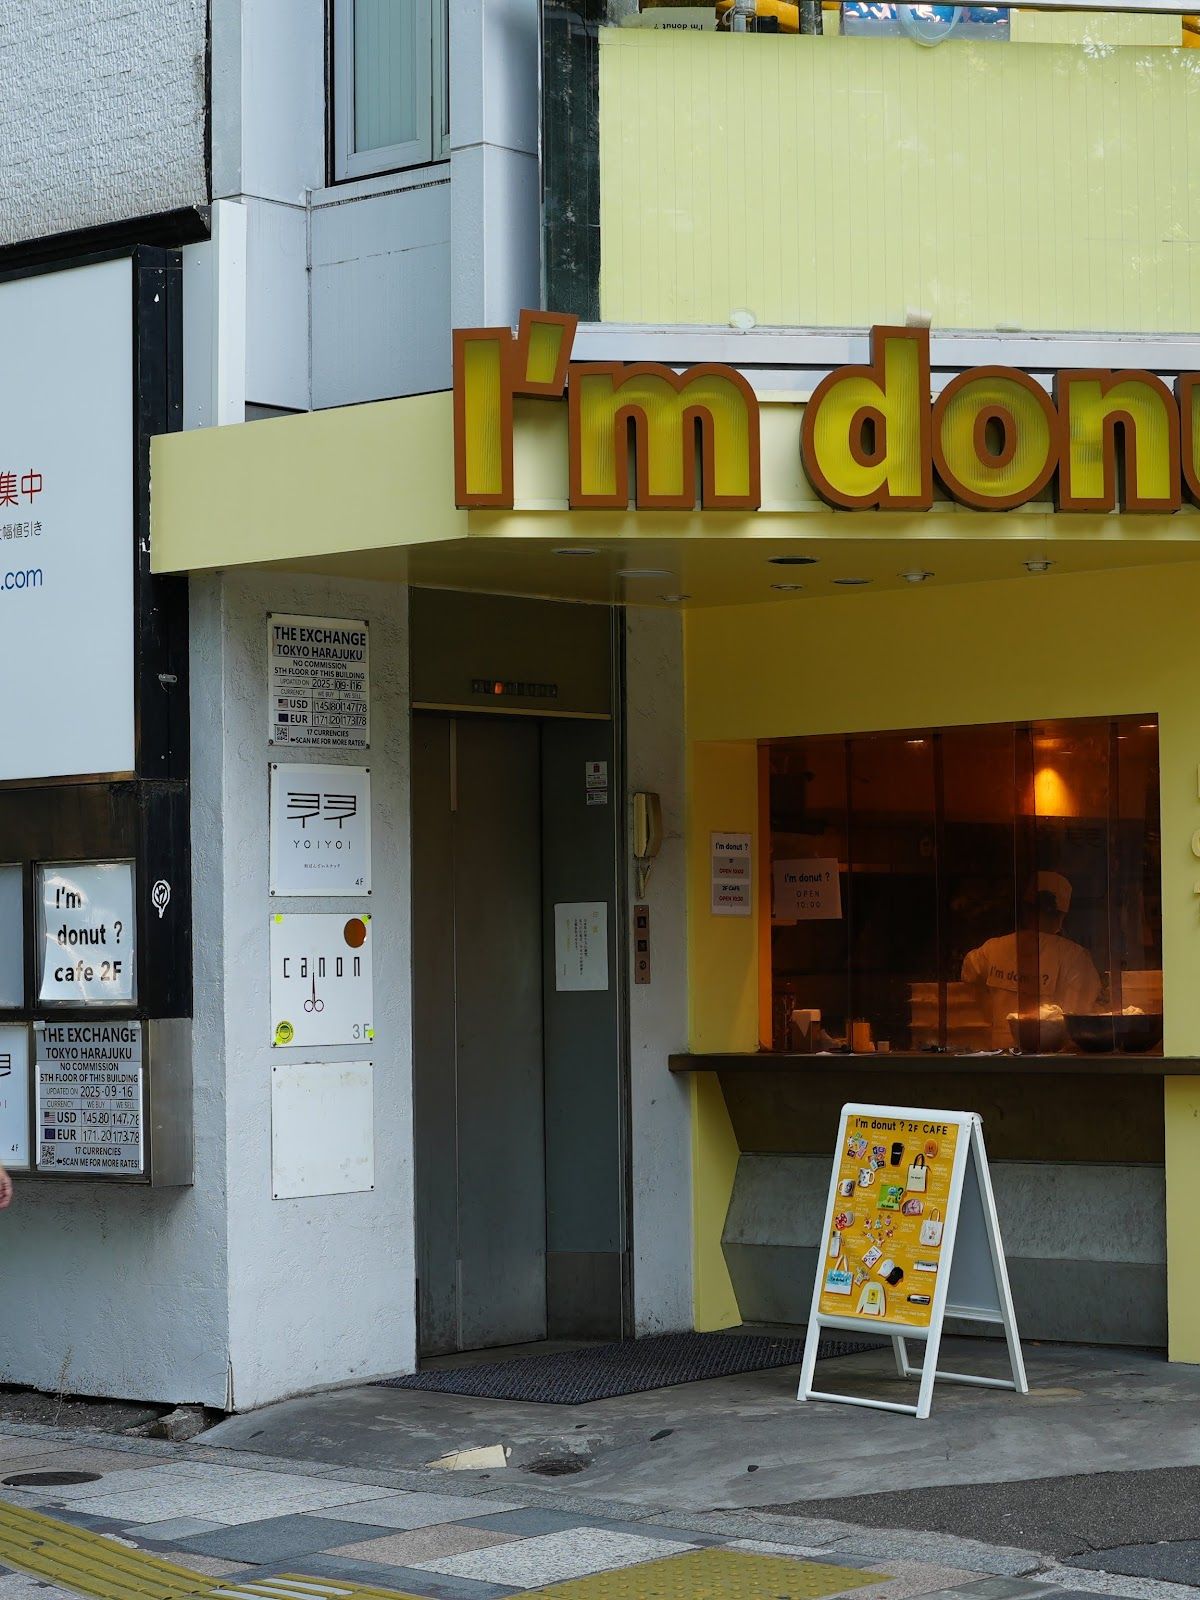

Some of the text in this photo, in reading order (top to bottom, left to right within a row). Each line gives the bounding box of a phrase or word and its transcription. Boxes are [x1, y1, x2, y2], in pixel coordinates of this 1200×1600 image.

[453, 309, 760, 511] I'm
[0, 521, 42, 540] 幅値引き
[0, 568, 42, 590] .com
[274, 626, 366, 646] THE EXCHANGE
[277, 644, 362, 660] TOKYO HARAJUKU
[305, 660, 346, 670] COMMISSION
[289, 668, 309, 676] FLOOR
[320, 670, 334, 678] THIS
[336, 671, 364, 679] BUILDING
[290, 700, 308, 709] USD
[290, 714, 308, 723] EUR
[314, 729, 348, 737] CURRENCIES
[293, 840, 351, 850] YOIYOI
[716, 842, 724, 850] I'm
[785, 873, 796, 883] I'm
[800, 874, 821, 883] donut
[56, 887, 82, 909] I'm
[58, 921, 122, 945] donut ?
[54, 960, 122, 982] cafe 2F
[283, 956, 361, 978] canon
[42, 1028, 137, 1042] THE EXCHANGE
[46, 1047, 132, 1059] TOKYO HARAJUKU
[60, 1062, 118, 1071] NO COMMISSION
[40, 1074, 138, 1083] 5TH FLOOR OF THIS BUILDING
[57, 1112, 77, 1123] USD
[855, 1118, 948, 1135] I'm donut ? 2F CAFE
[57, 1129, 76, 1140] EUR
[83, 1147, 121, 1155] CURRENCIES
[62, 1158, 78, 1166] SCAN
[90, 1159, 101, 1167] FOR
[102, 1159, 119, 1167] MORE
